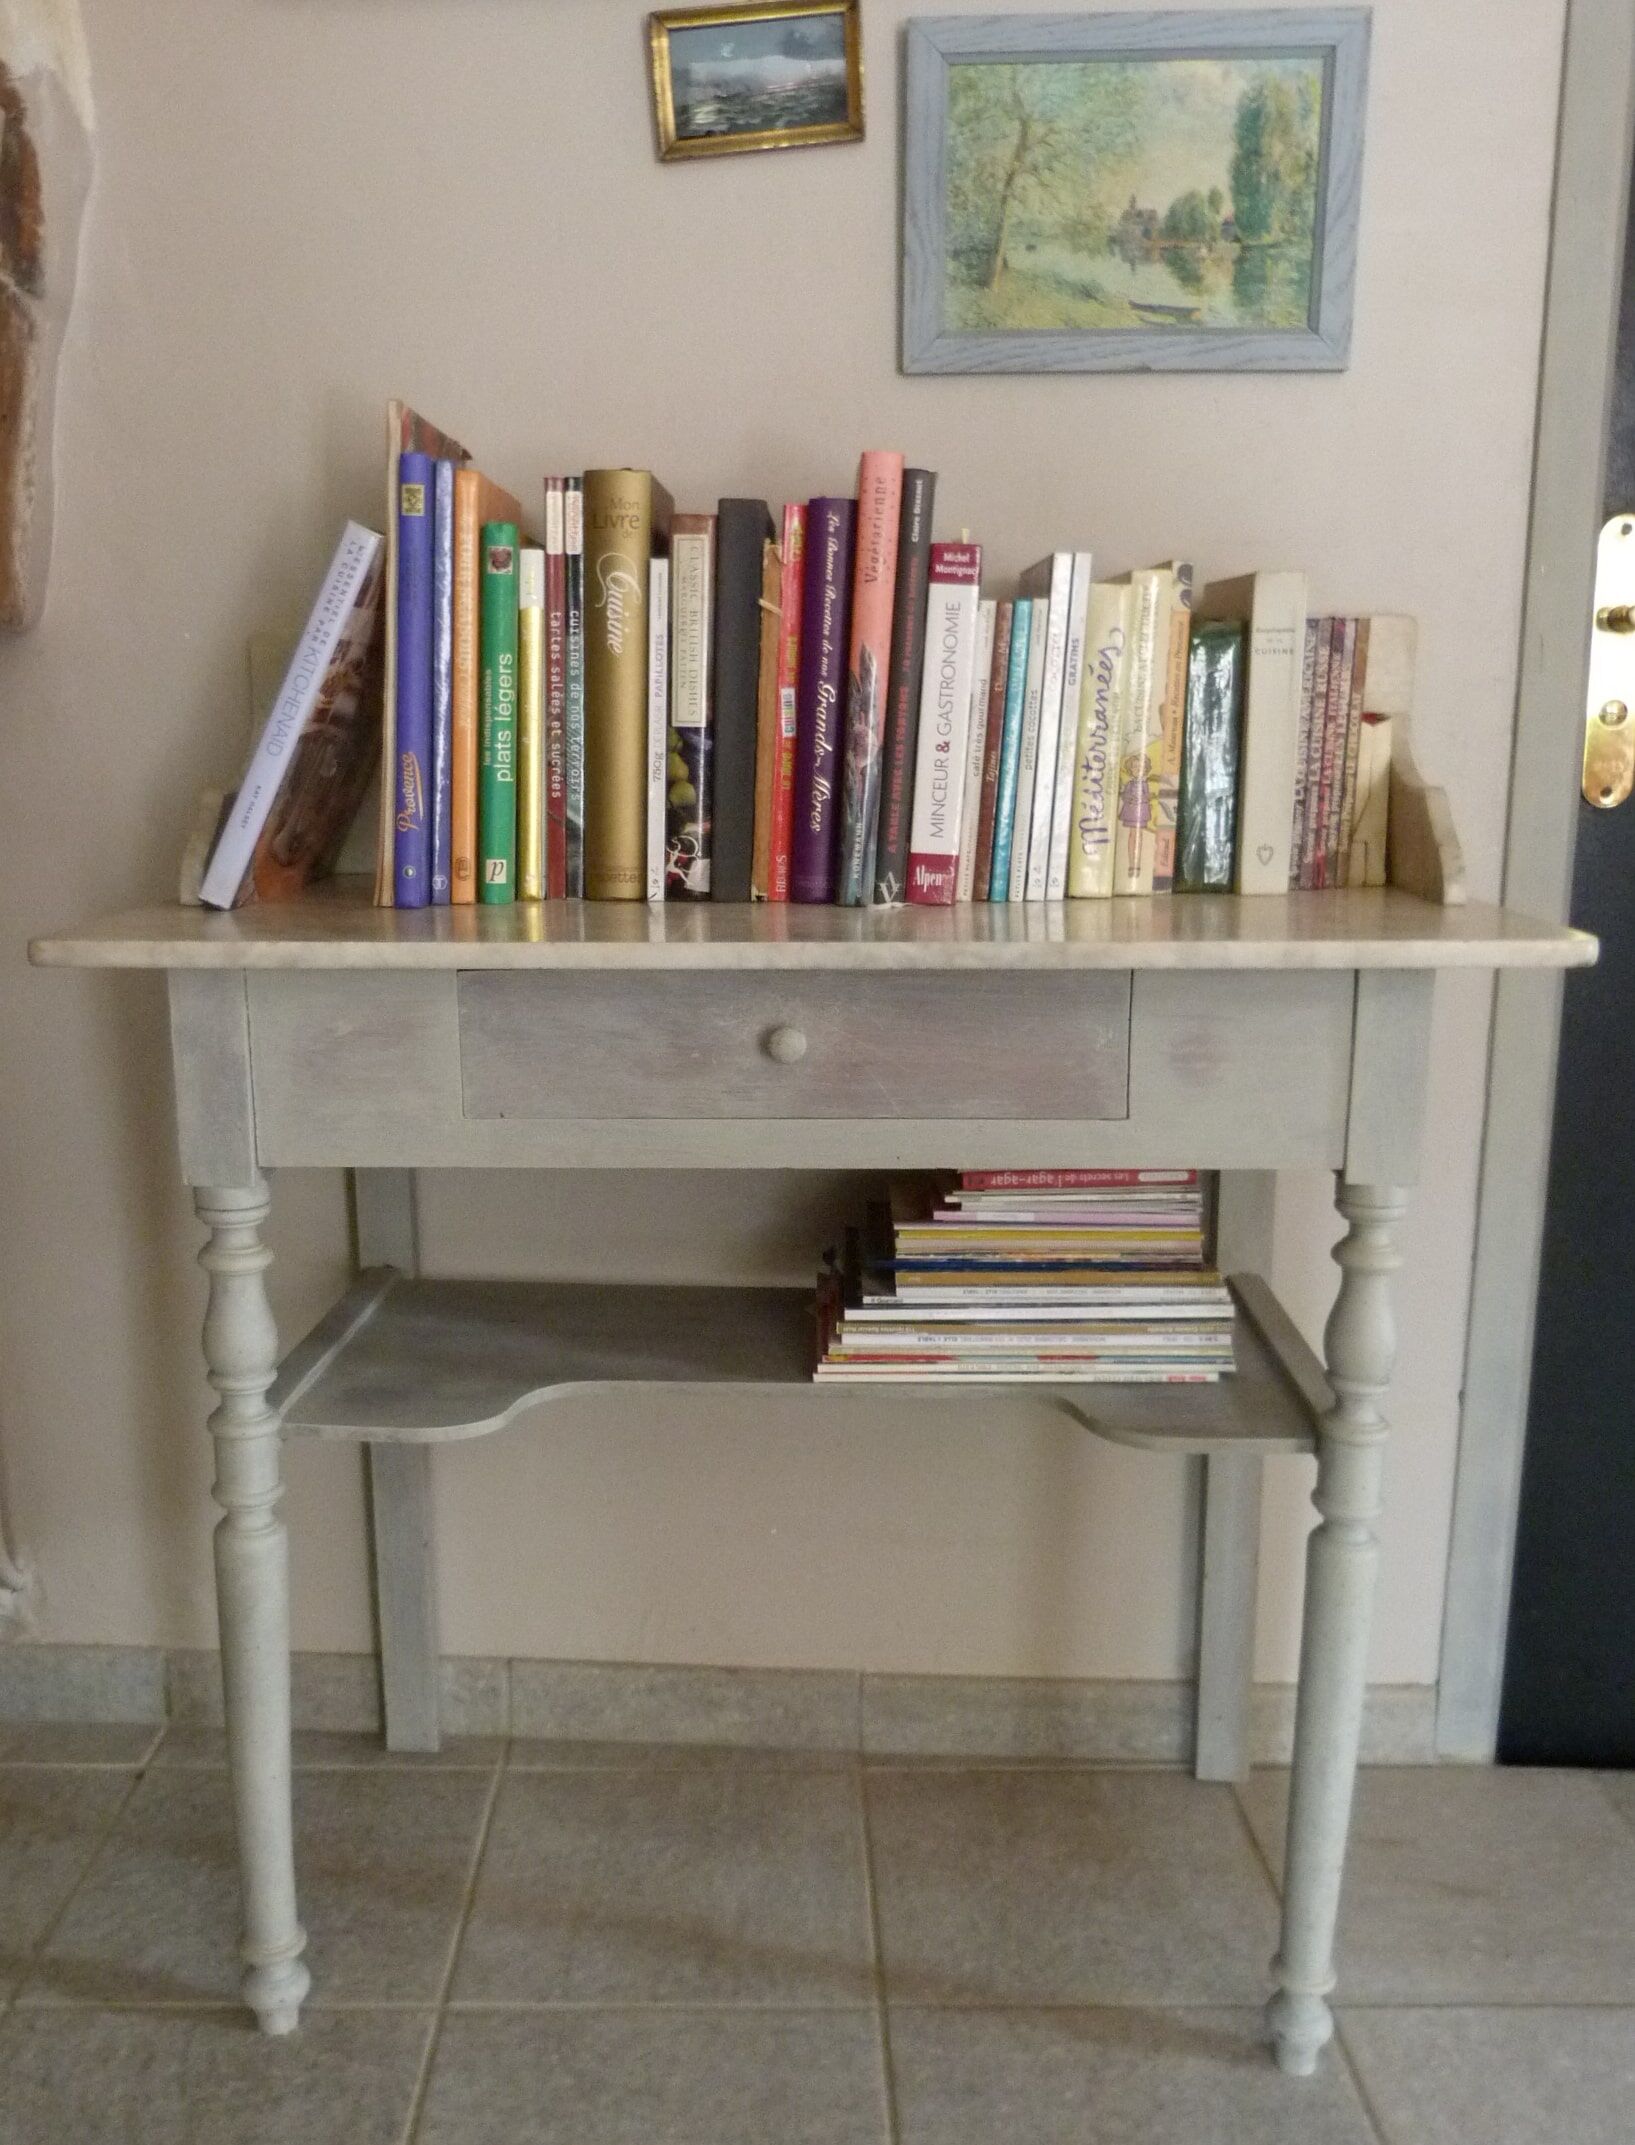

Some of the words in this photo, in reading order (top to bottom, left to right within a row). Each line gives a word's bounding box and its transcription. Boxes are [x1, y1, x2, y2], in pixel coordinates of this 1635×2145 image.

[593, 513, 640, 529] Livre
[610, 498, 640, 510] Mon
[864, 476, 887, 583] Végétarienne
[689, 546, 699, 600] CLASSIC
[596, 553, 642, 656] Cuisine
[822, 585, 837, 636] Recettes
[550, 611, 563, 660] tartes
[569, 610, 582, 678] cuisines
[821, 639, 833, 653] de
[492, 653, 514, 721] légers
[653, 634, 664, 698] PAPILLOTES
[938, 601, 961, 736] GASTRONOMIE
[1068, 638, 1079, 686] GRATINS
[1315, 646, 1329, 692] RUSSE
[265, 645, 321, 758] KITCHENAID
[482, 669, 493, 747] indispensables
[570, 683, 582, 699] de
[976, 678, 987, 730] gourmand
[1027, 689, 1038, 733] cocottes
[551, 720, 563, 738] et
[570, 705, 582, 730] nos
[974, 732, 984, 753] très
[1310, 697, 1326, 757] CUISINE
[483, 750, 492, 766] les
[494, 730, 514, 782] plats
[550, 743, 564, 798] sucrées
[569, 736, 582, 801] terroirs
[652, 752, 664, 782] 750g
[810, 680, 836, 833] Grands-Mères
[935, 741, 950, 754] &
[972, 755, 981, 777] café
[1023, 734, 1037, 771] petites
[1309, 761, 1321, 782] LA
[396, 750, 420, 833] Provence
[930, 758, 948, 838] MINCEUR
